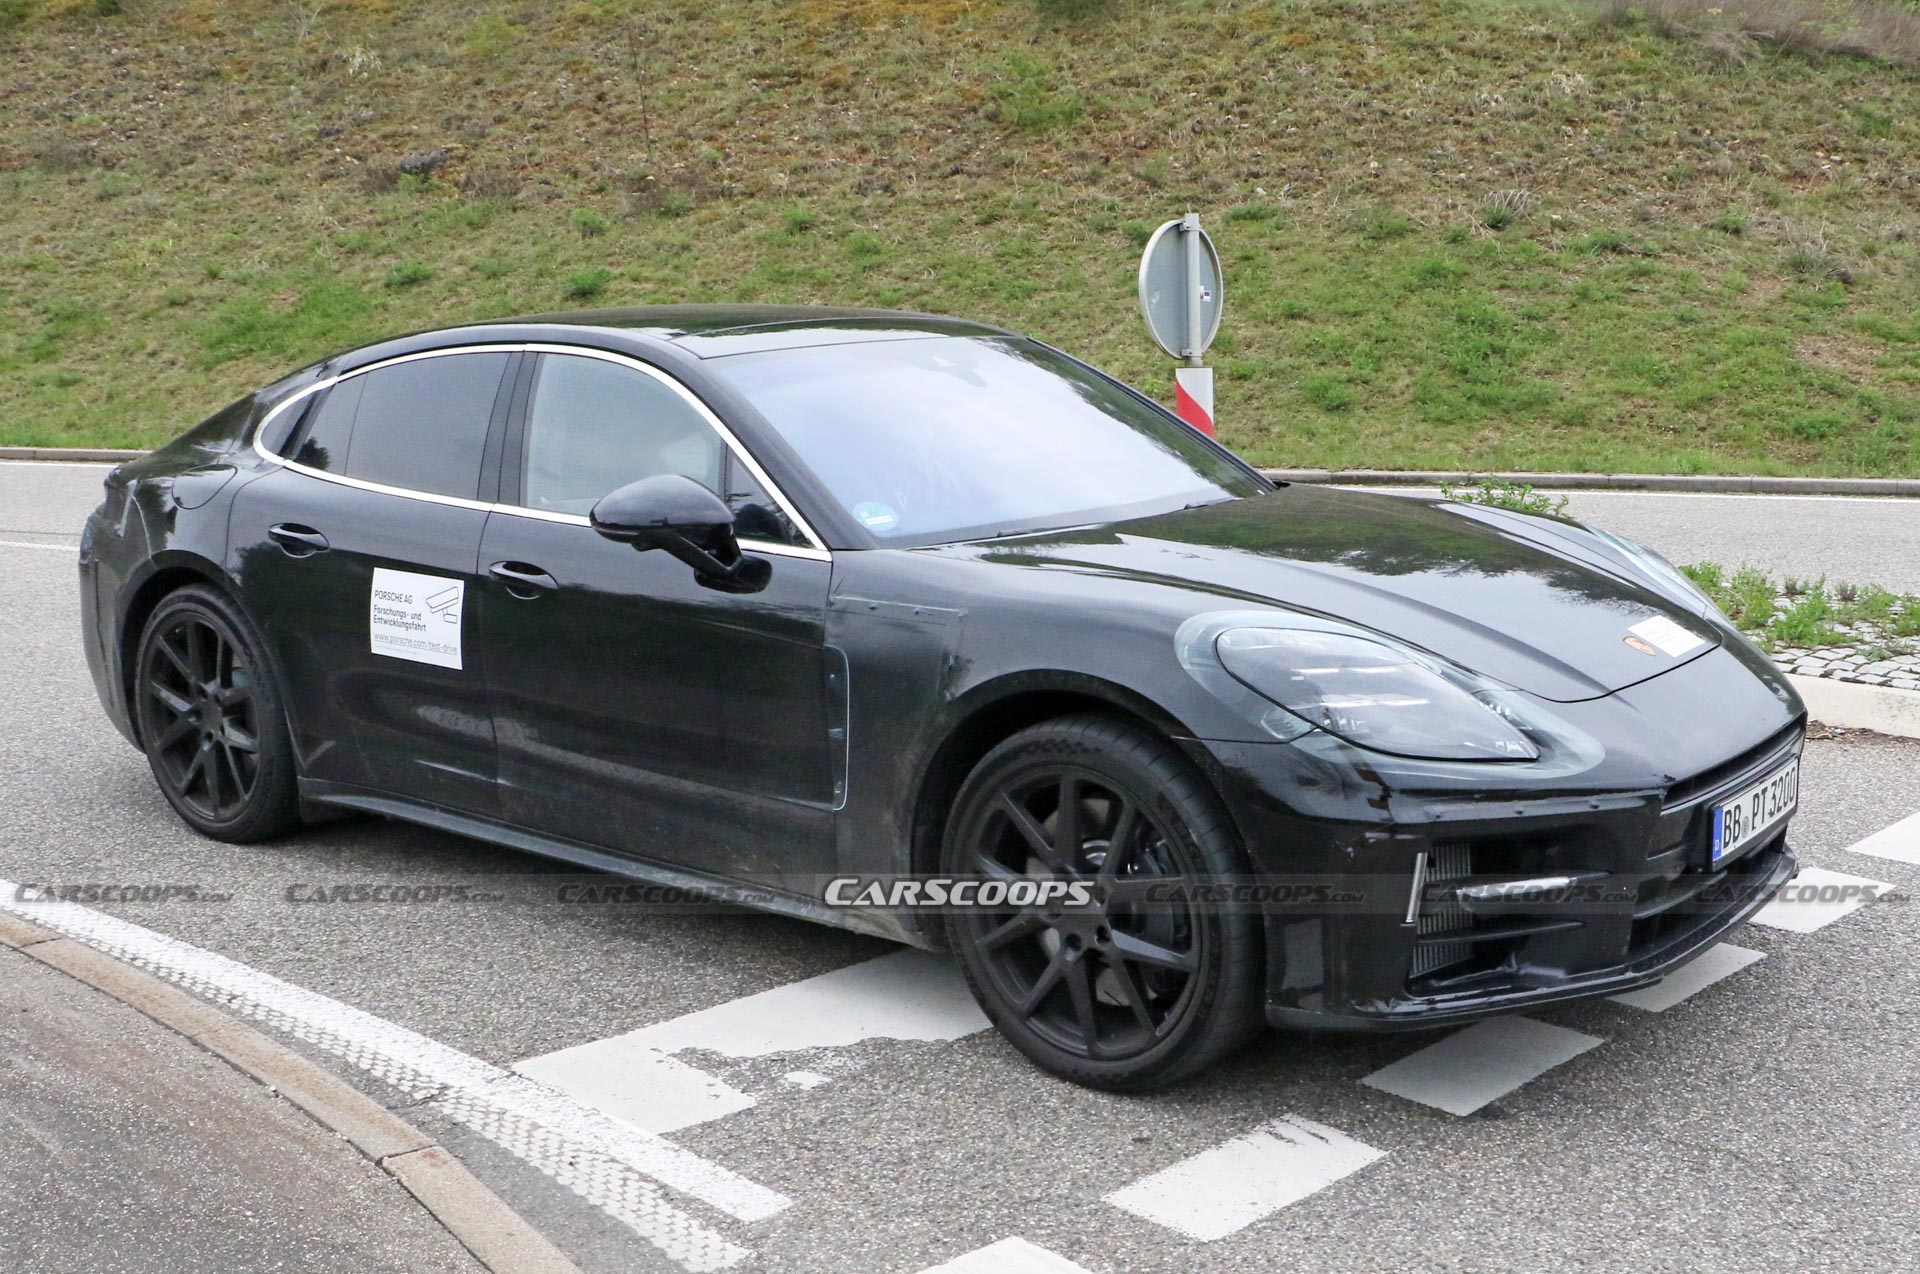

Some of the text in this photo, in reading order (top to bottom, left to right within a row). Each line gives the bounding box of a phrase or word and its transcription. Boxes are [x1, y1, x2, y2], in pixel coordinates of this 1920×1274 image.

[374, 590, 413, 605] PORSCHE AG
[373, 604, 422, 621] Forschungs- und
[373, 615, 427, 632] Entwicklungsfahrt
[1723, 766, 1796, 849] BB PT 3200
